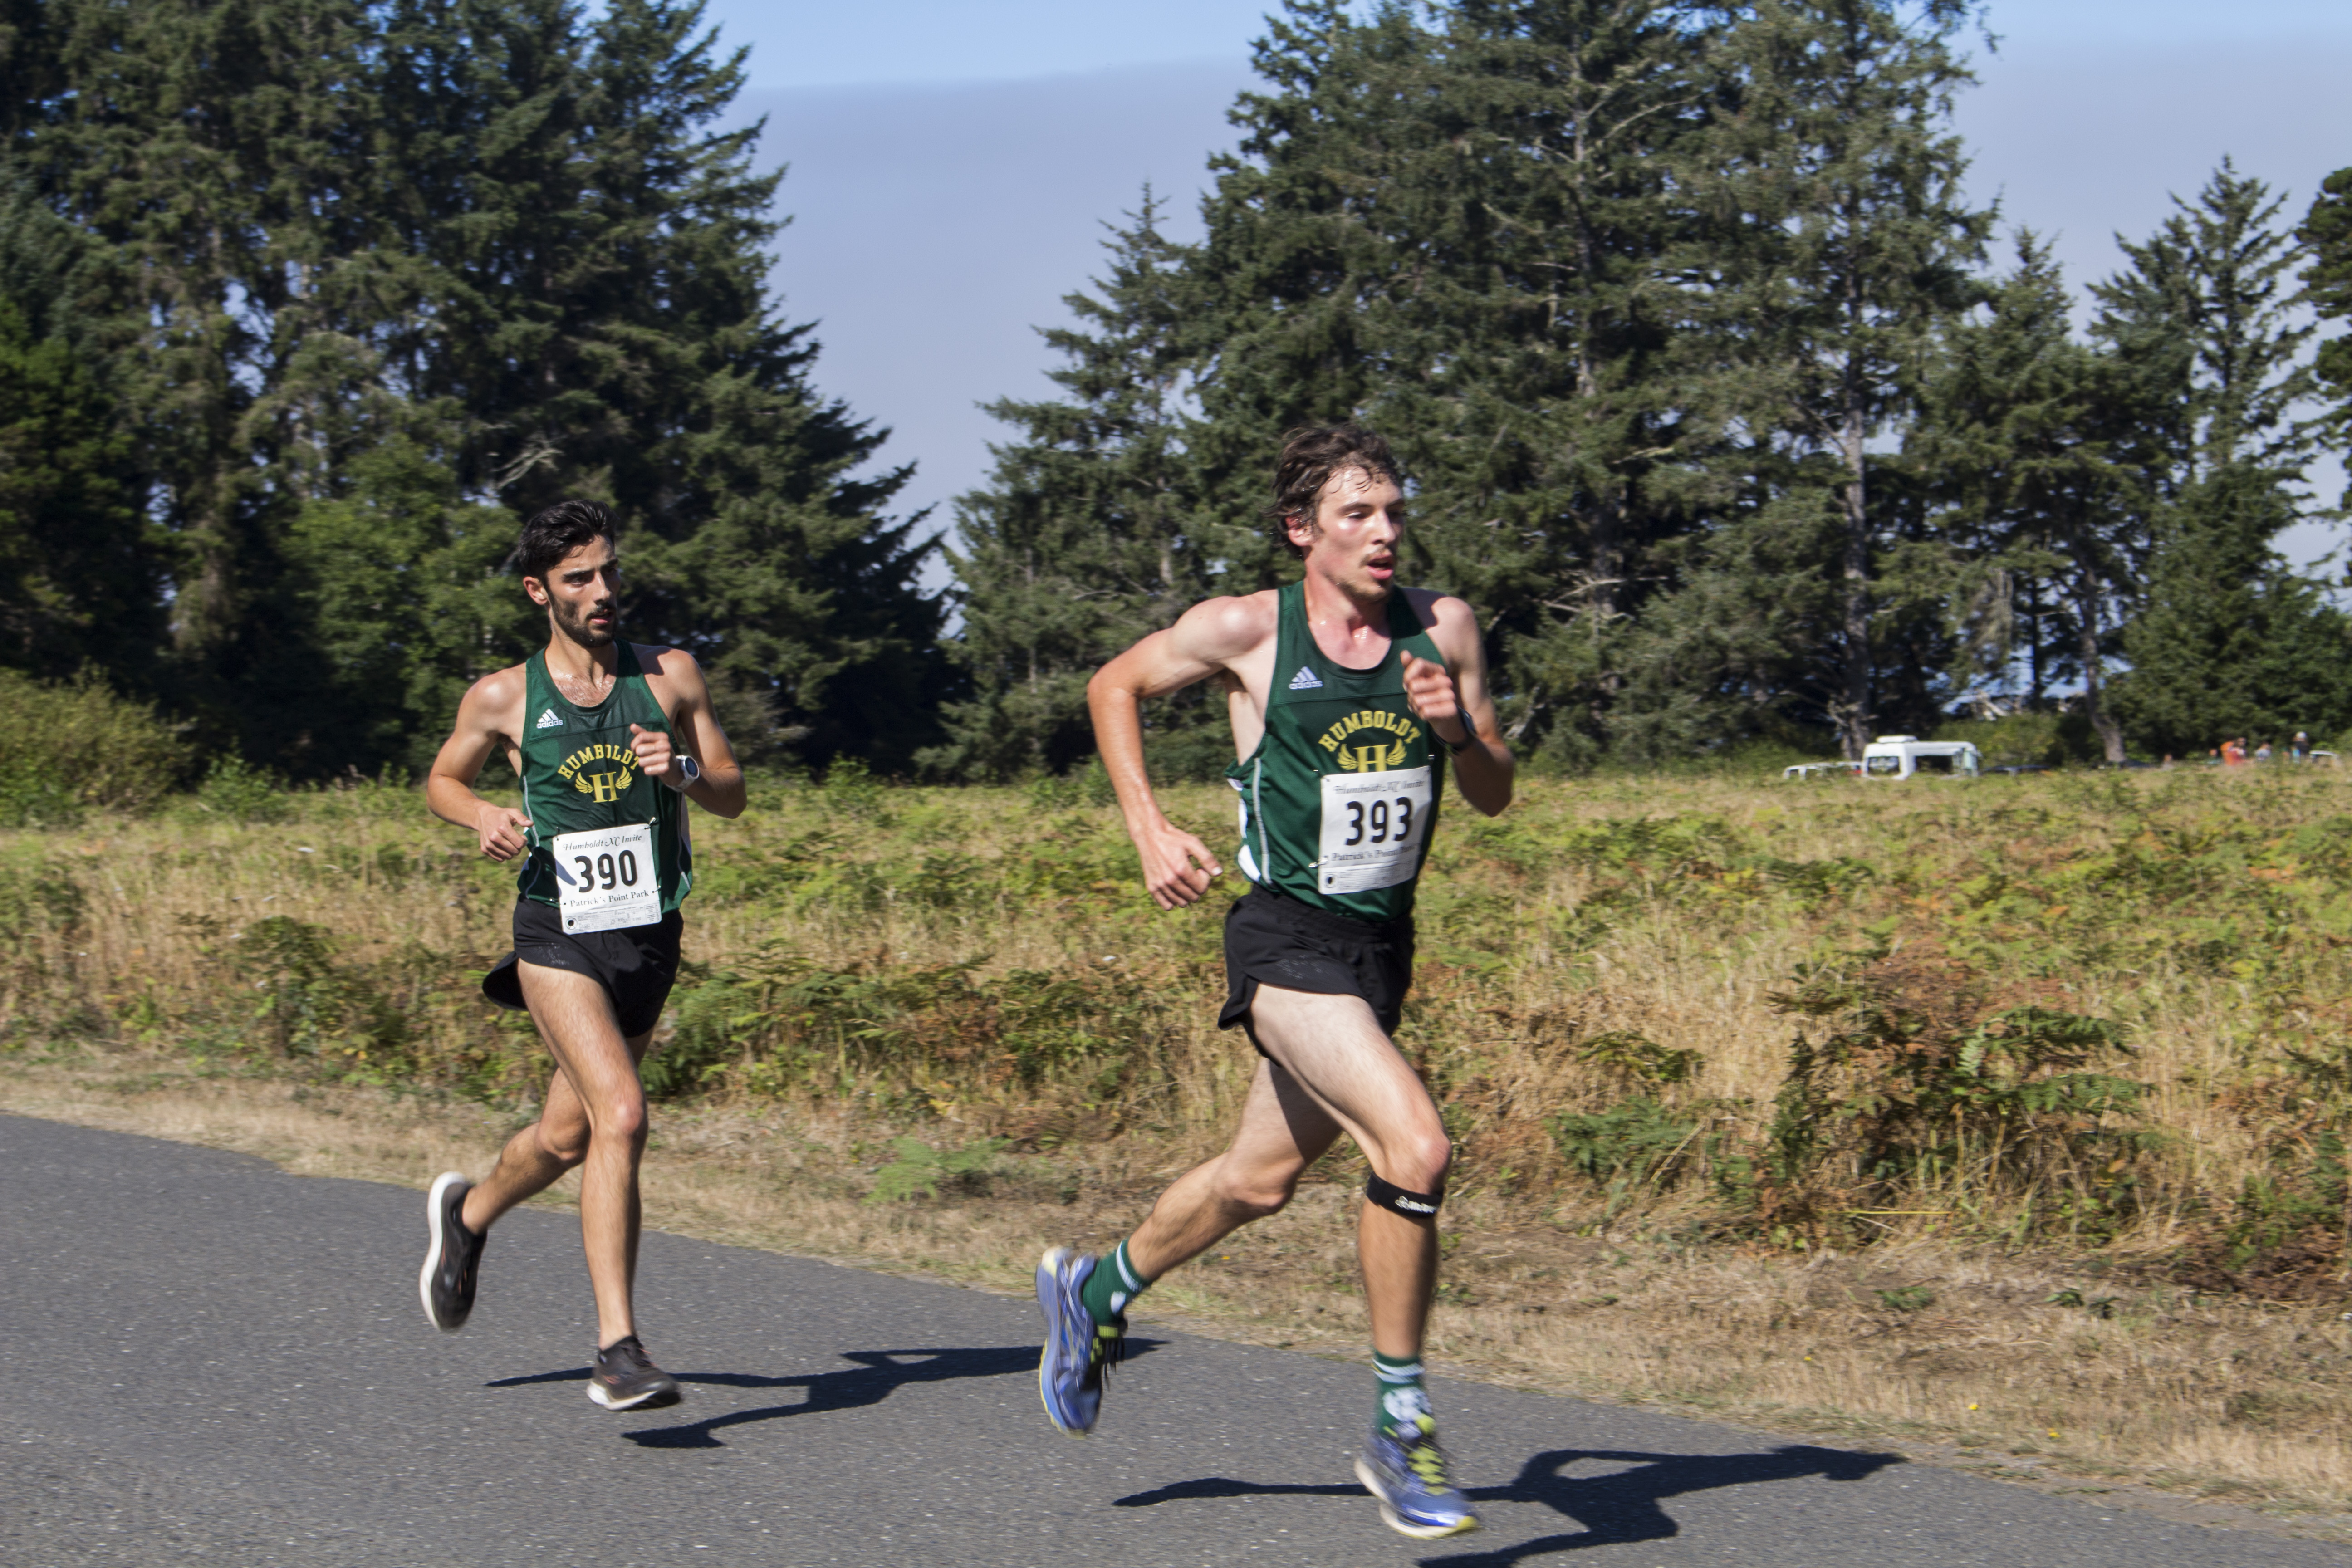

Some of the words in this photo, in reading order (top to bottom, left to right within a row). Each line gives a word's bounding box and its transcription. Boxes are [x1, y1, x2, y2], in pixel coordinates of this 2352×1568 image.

[536, 719, 564, 729] adidas
[1318, 710, 1422, 752] HUMBOLDT
[1352, 744, 1391, 773] H
[589, 771, 620, 803] H
[1345, 796, 1414, 847] 393
[563, 839, 603, 851] Humboldt
[605, 837, 620, 847] XC
[622, 834, 642, 843] Invite
[574, 850, 638, 893] 390
[570, 897, 606, 907] Patrick's
[608, 893, 628, 902] Point
[631, 890, 650, 899] Park
